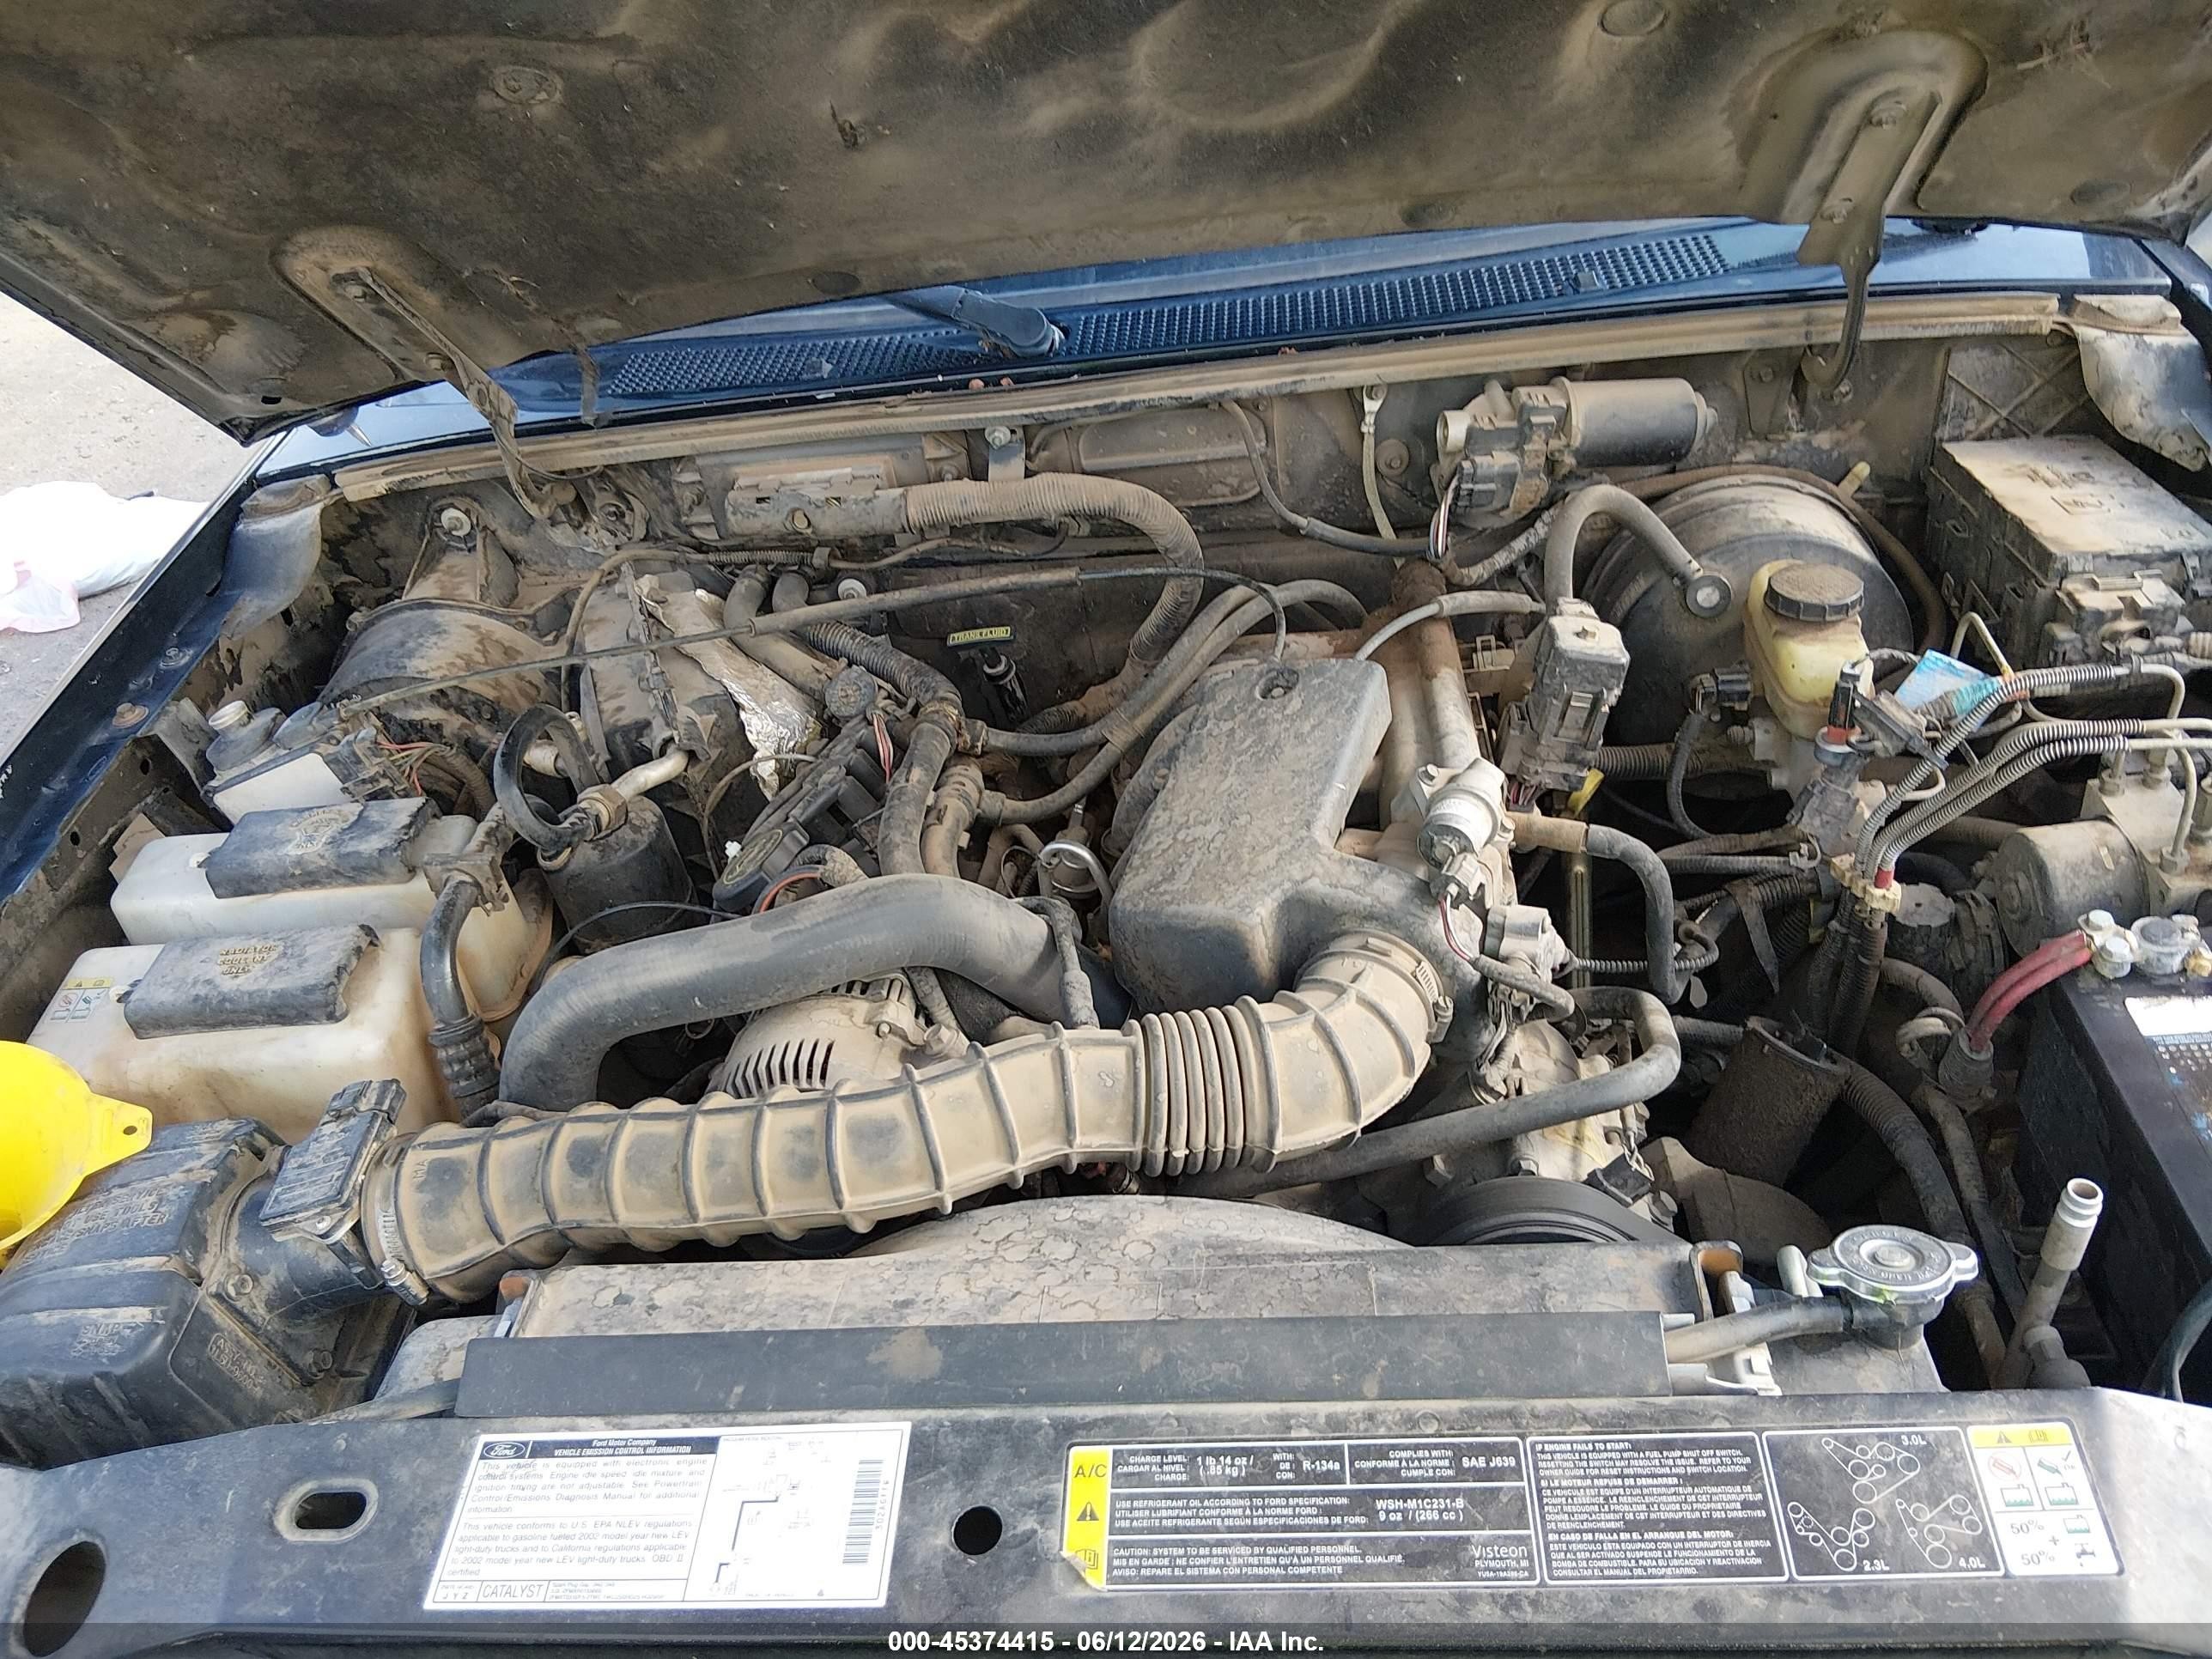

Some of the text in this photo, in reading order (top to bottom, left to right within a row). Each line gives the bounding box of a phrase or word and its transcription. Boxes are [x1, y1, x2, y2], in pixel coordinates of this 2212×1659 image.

[1900, 1435, 1927, 1446] 3.0L
[490, 1444, 517, 1456] Ford
[1462, 1456, 1486, 1468] SAE
[1074, 1463, 1108, 1478] A/C
[1471, 1544, 1528, 1559] Visteon
[1863, 1560, 1889, 1571] 2.3L
[480, 1583, 546, 1599] CATALYST
